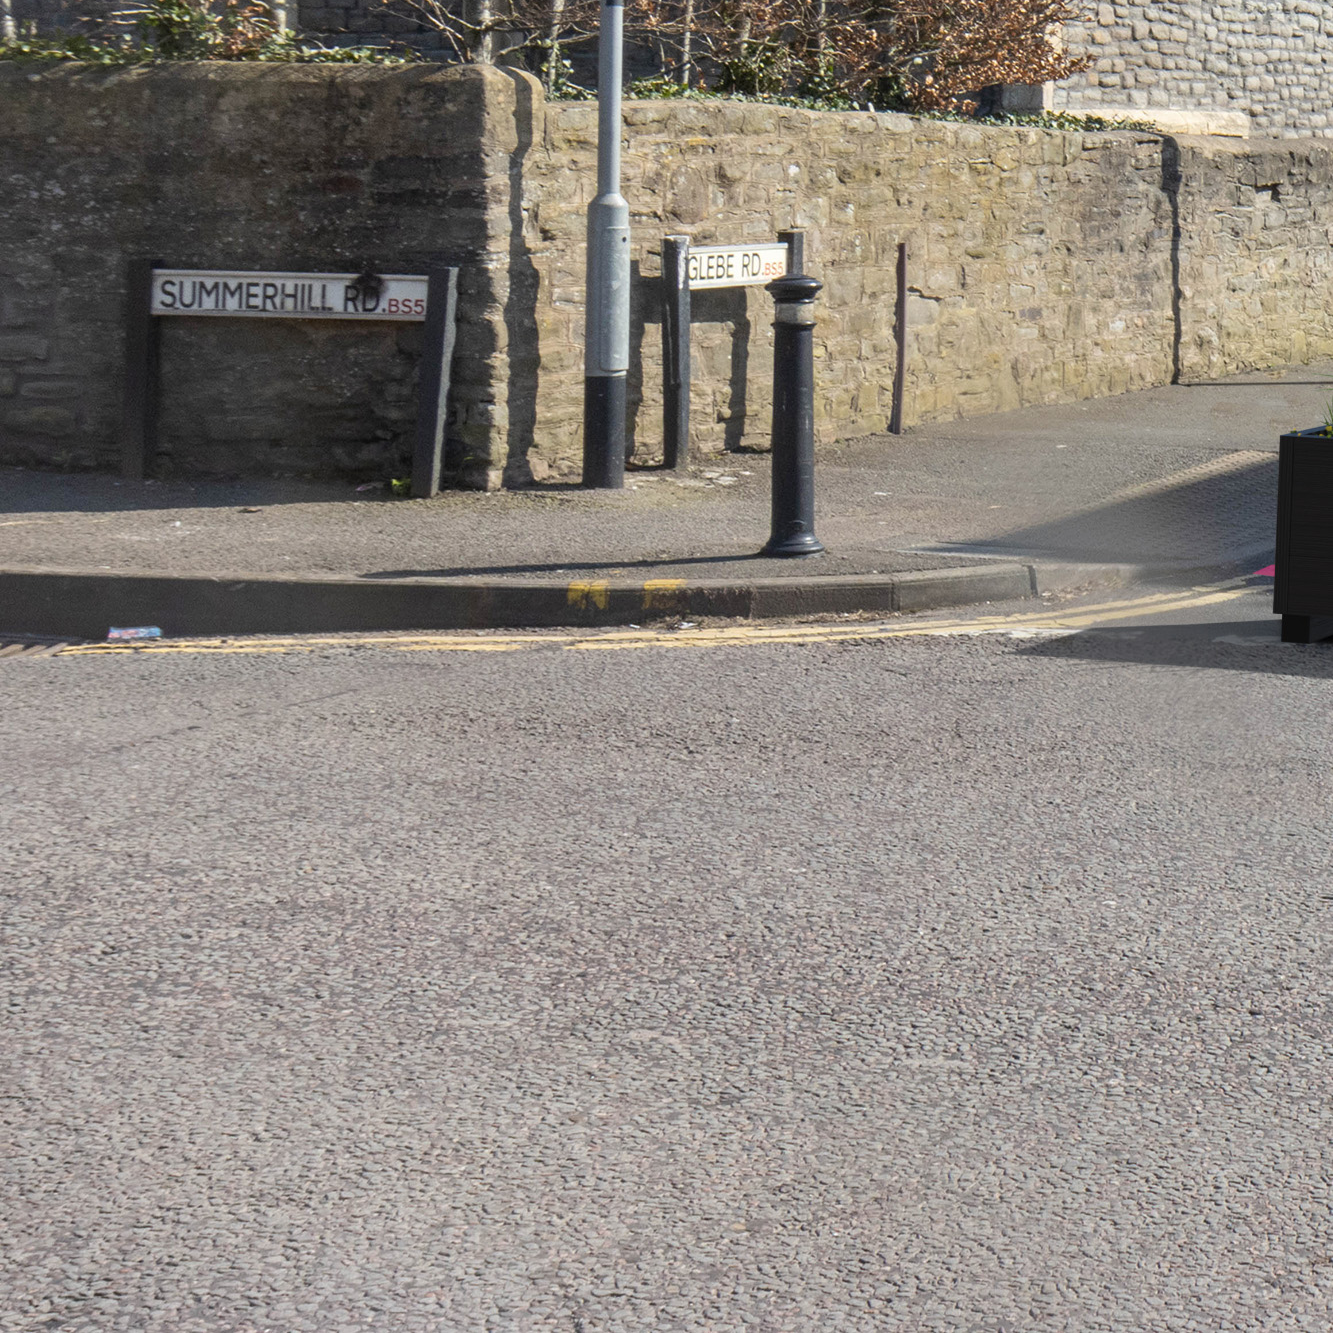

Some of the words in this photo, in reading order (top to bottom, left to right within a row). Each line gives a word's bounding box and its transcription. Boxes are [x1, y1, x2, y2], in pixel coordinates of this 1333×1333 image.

[688, 254, 734, 281] GLEBE
[764, 262, 784, 276] BS5
[160, 280, 334, 311] SUMMERHILL
[387, 298, 425, 315] BS5
